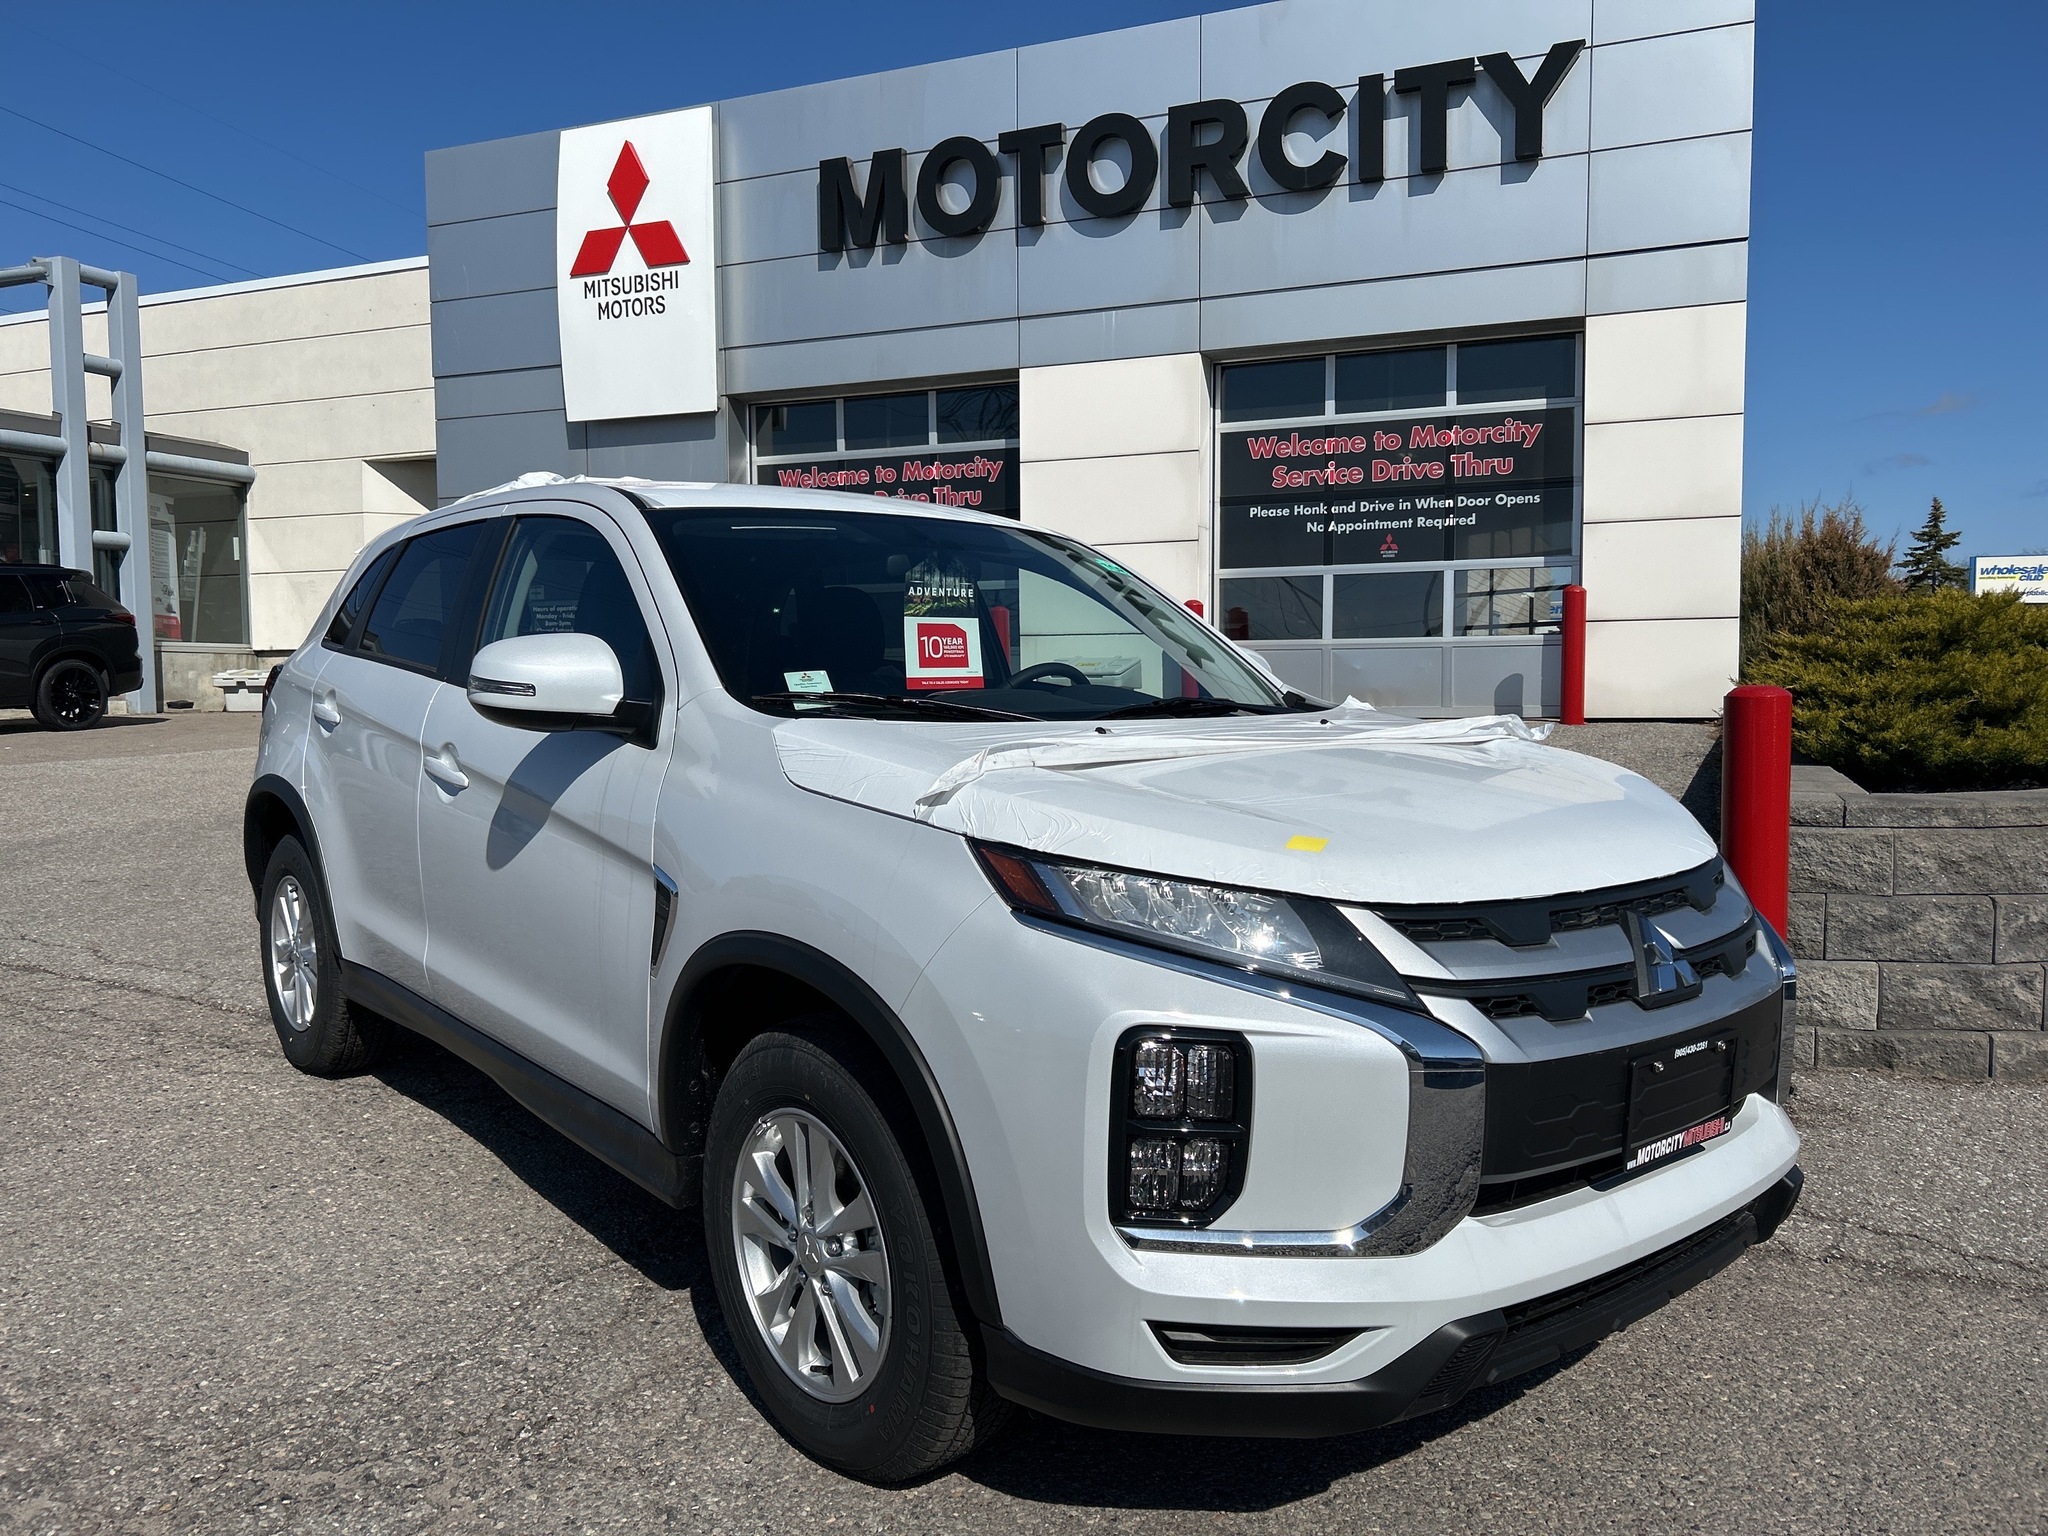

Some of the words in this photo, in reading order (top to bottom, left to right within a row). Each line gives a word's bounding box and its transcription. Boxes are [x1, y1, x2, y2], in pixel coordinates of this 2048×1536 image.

[819, 38, 1587, 252] MOTORCITY
[584, 270, 679, 299] MITSUBISHI
[598, 295, 666, 320] MOTORS
[1247, 432, 1366, 459] Welcome
[1374, 431, 1402, 451] to
[1409, 418, 1543, 448] Motorcity
[778, 466, 870, 489] Welcome
[875, 465, 897, 483] to
[902, 456, 1003, 482] Motorcity
[1271, 461, 1363, 488] Service
[1371, 456, 1444, 483] Drive
[1451, 452, 1514, 478] Thru
[933, 485, 982, 507] Thru
[1249, 506, 1290, 518] Please
[1294, 503, 1327, 516] Honk
[1331, 502, 1356, 514] and
[1360, 500, 1395, 513] Drive
[1398, 499, 1411, 511] in
[1415, 497, 1453, 510] When
[1457, 495, 1491, 508] Door
[1495, 494, 1541, 507] Opens
[1306, 522, 1324, 533] No
[1328, 518, 1413, 534] Appointment
[1417, 514, 1476, 530] Required
[1980, 564, 2048, 575] wholesale
[2019, 573, 2044, 581] club
[908, 587, 974, 598] ADVENTURE
[920, 635, 943, 658] 10
[942, 637, 963, 645] YEAR
